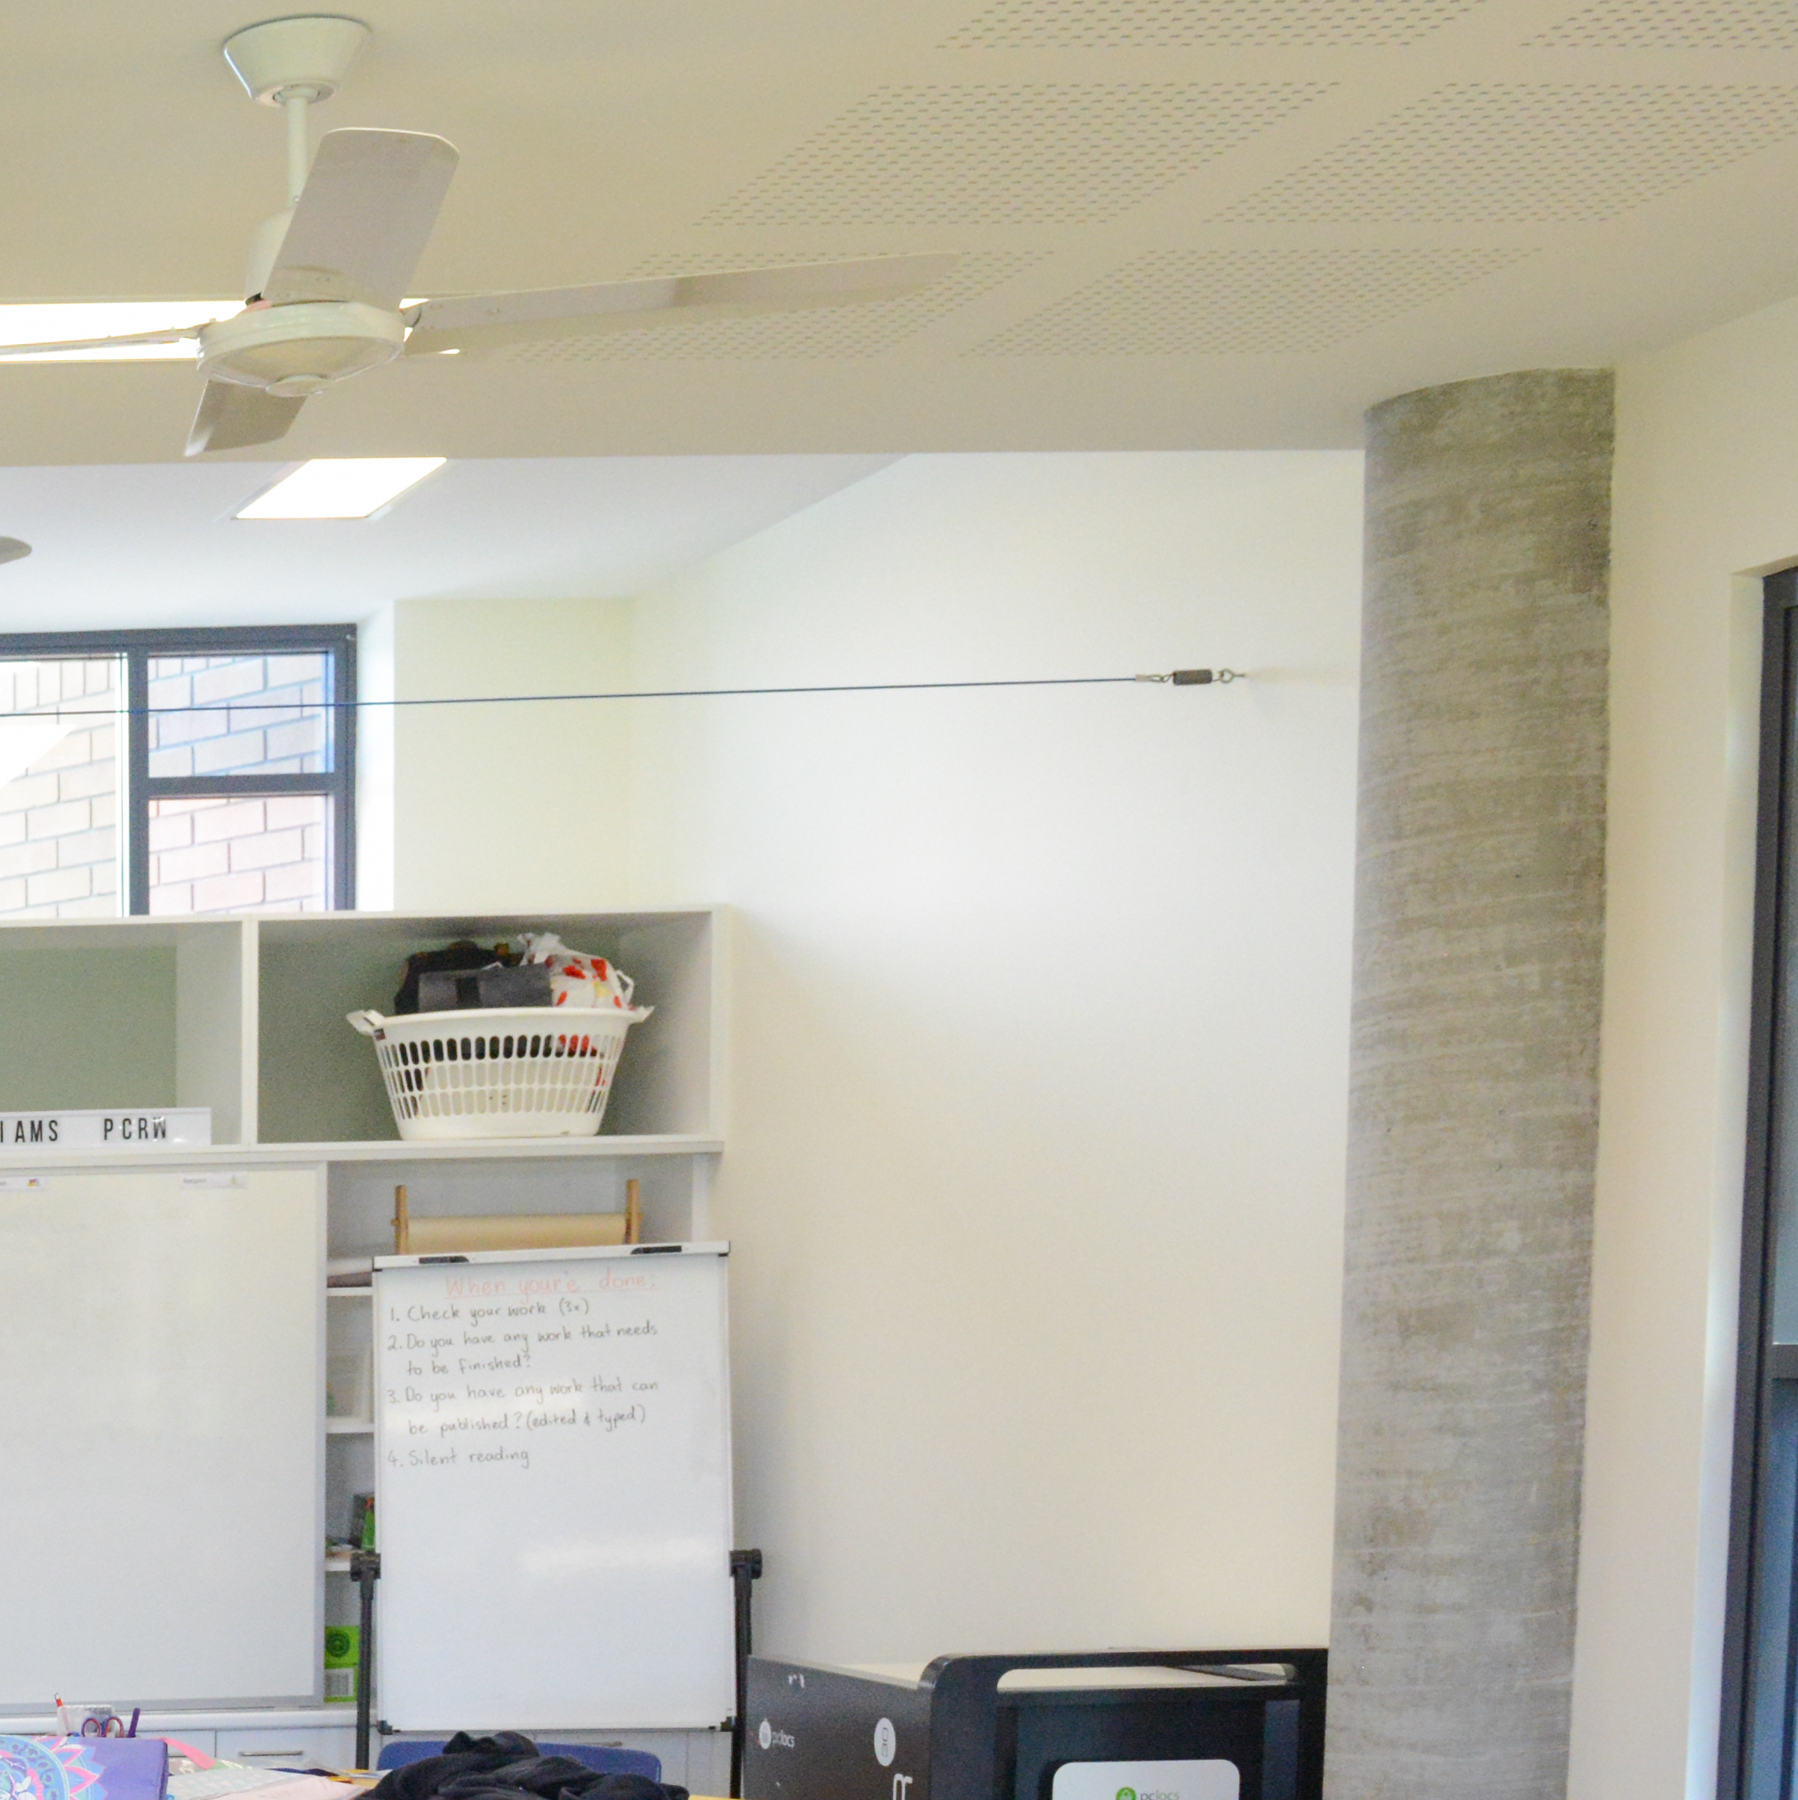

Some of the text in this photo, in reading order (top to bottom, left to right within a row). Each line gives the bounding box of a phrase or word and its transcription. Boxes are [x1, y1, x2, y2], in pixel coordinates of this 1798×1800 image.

[103, 1116, 168, 1142] PCRW
[445, 1277, 505, 1299] When
[598, 1267, 656, 1291] done:
[389, 1297, 590, 1327] 1. Check your work (3x)
[387, 1319, 658, 1357] 2. Do you have any work that needs
[407, 1353, 532, 1376] to be finished?
[405, 1386, 423, 1402] Do
[430, 1391, 457, 1412] you
[466, 1384, 505, 1399] have
[514, 1386, 544, 1405] any
[549, 1377, 584, 1395] work
[591, 1376, 623, 1391] that
[631, 1380, 660, 1392] can
[408, 1418, 428, 1436] be
[597, 1403, 647, 1433] typed)
[408, 1448, 458, 1467] Silent
[469, 1446, 530, 1469] reading
